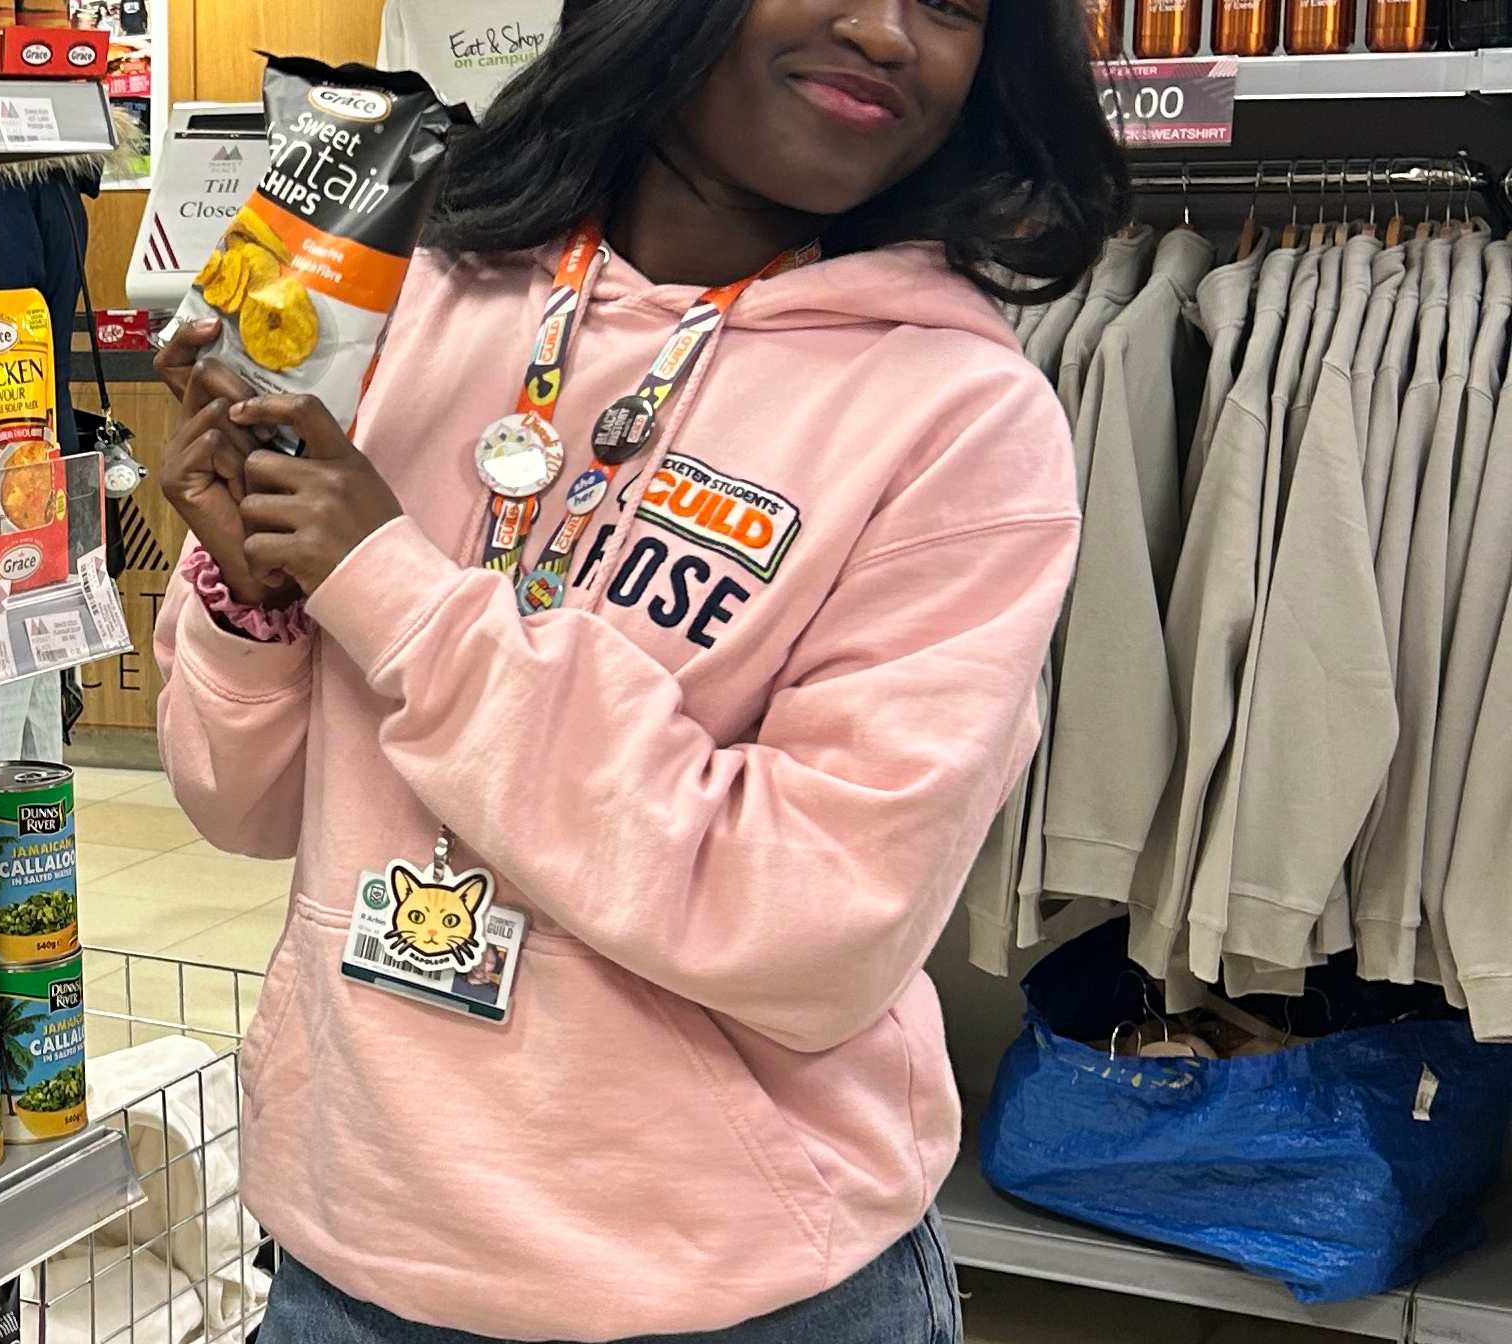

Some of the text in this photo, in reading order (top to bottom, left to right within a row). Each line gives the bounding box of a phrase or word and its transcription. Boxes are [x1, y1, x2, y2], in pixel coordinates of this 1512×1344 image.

[449, 26, 544, 58] Eat & Shop
[454, 57, 473, 69] on
[289, 112, 361, 157] Sweet
[204, 178, 239, 194] Till
[542, 320, 560, 363] GUILD
[662, 335, 693, 376] GUILD
[661, 459, 712, 487] EXETER
[642, 471, 773, 549] GUILD
